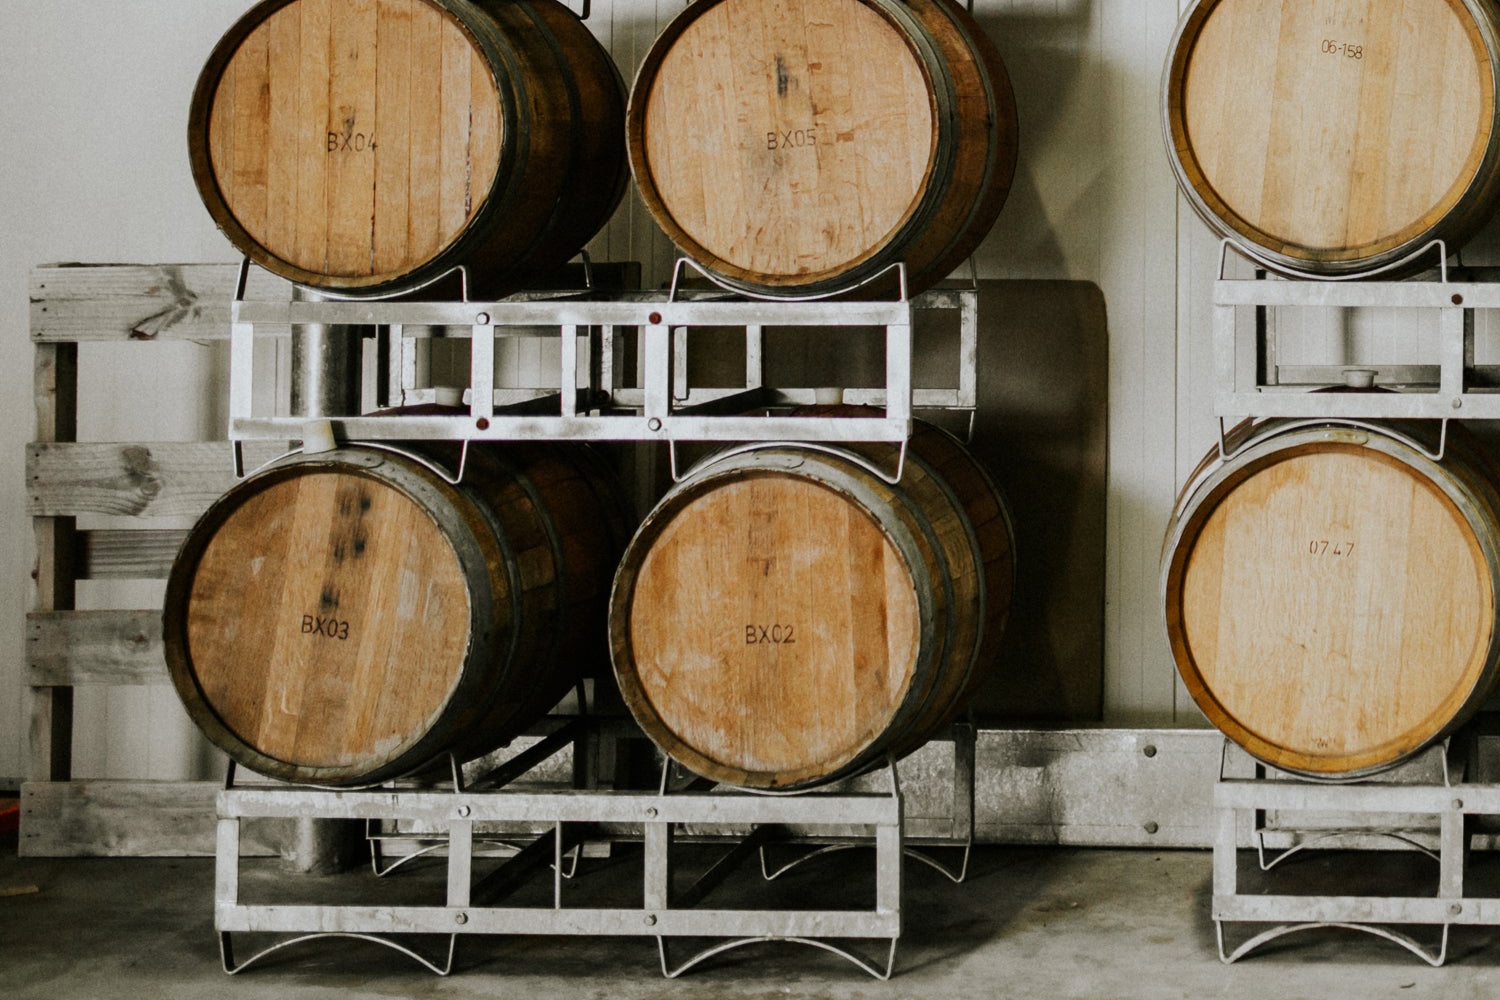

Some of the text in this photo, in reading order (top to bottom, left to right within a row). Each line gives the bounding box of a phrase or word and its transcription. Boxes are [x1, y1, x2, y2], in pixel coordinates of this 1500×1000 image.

[1321, 39, 1363, 60] 06-158
[327, 132, 378, 152] BX04
[767, 128, 817, 150] BX05
[301, 615, 349, 640] BX03
[745, 624, 796, 645] BX02
